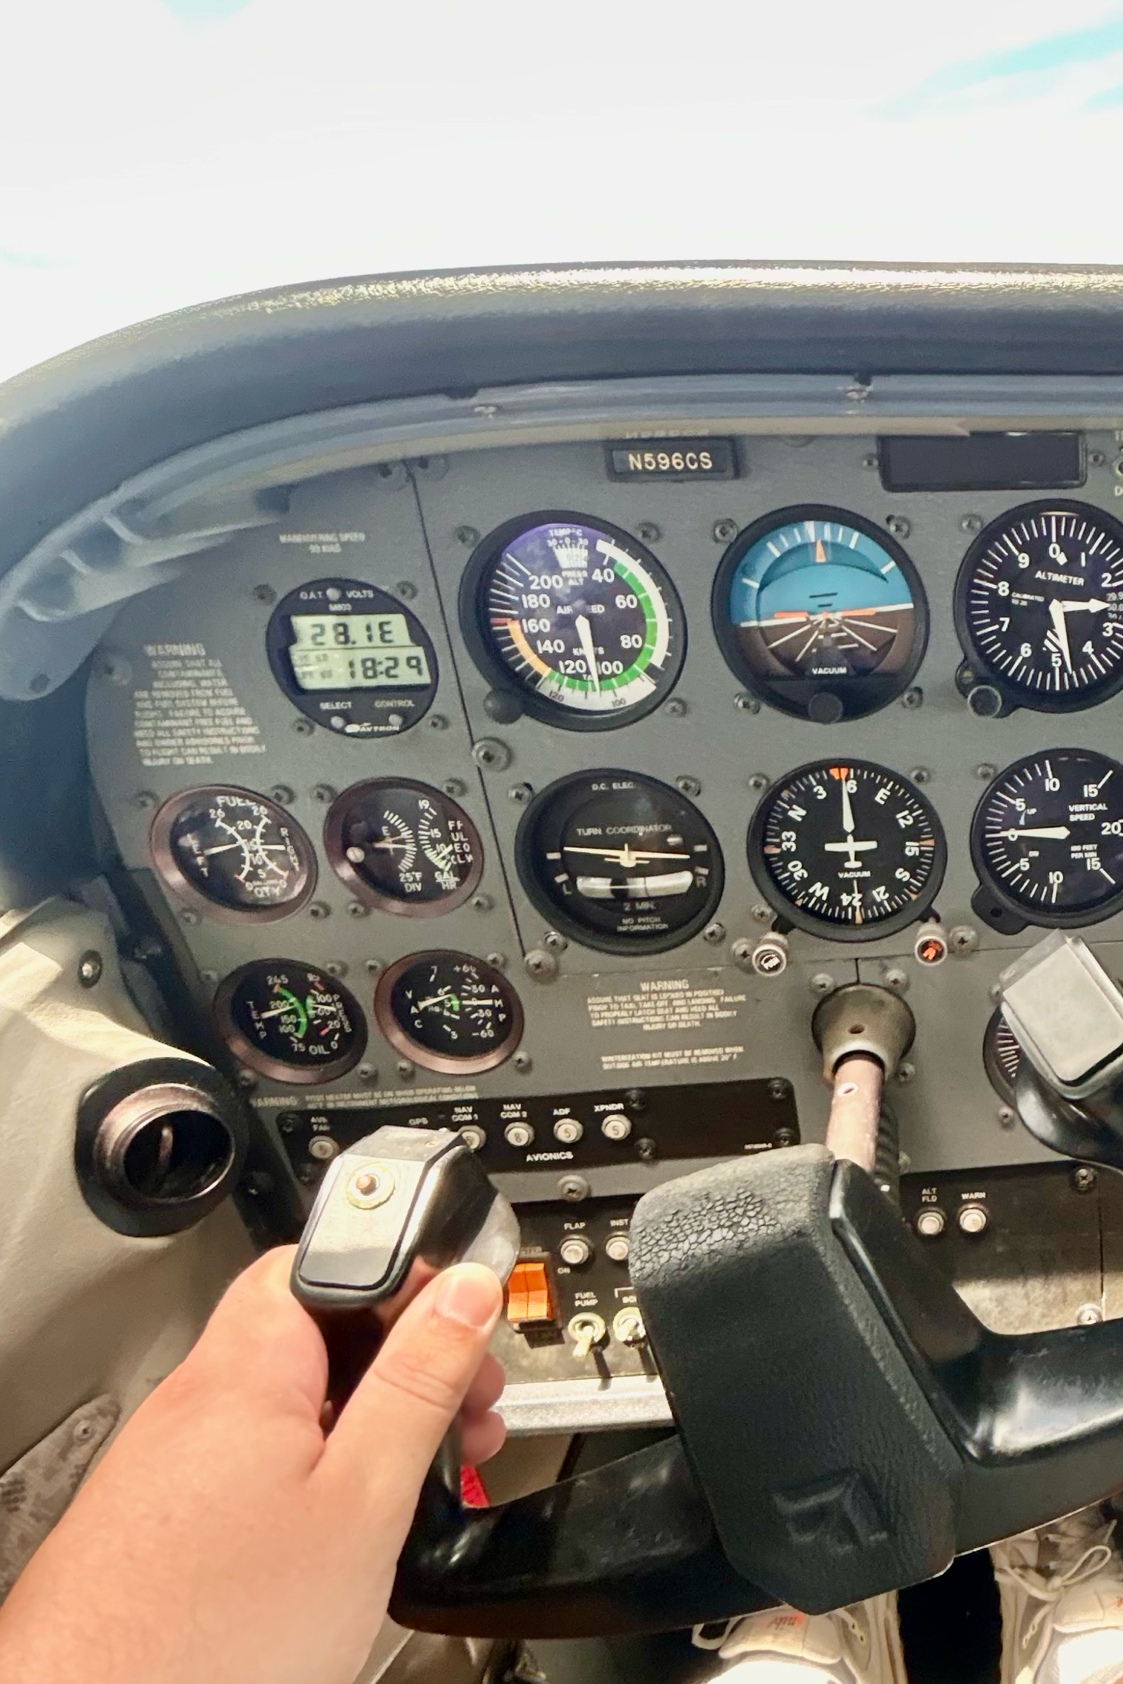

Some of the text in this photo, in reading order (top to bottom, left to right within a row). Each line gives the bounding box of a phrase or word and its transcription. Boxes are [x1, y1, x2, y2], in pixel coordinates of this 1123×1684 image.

[628, 452, 712, 470] N596CS
[1018, 553, 1030, 568] 9
[529, 575, 563, 590] 200
[592, 568, 614, 584] 40
[1035, 570, 1085, 587] ALTIMETER
[346, 590, 374, 598] VOLTS
[998, 581, 1010, 596] 8
[522, 594, 550, 609] 180
[615, 595, 638, 609] 60
[522, 620, 550, 633] 160
[999, 618, 1010, 632] 7
[1103, 622, 1114, 637] 3
[536, 639, 565, 653] 140
[620, 635, 642, 649] 80
[1082, 641, 1094, 654] 4
[143, 643, 206, 657] WARNING
[1020, 643, 1032, 657] 6
[559, 660, 586, 674] 120
[1051, 654, 1062, 667] 5
[348, 656, 423, 680] 18:29
[597, 660, 623, 675] 100
[812, 667, 847, 675] VACUUM
[846, 780, 858, 793] 6
[1045, 778, 1060, 791] 10
[1083, 784, 1098, 797] 15
[813, 785, 827, 799] 3
[874, 788, 891, 804] E
[216, 795, 257, 807] FUEL
[1015, 798, 1026, 811] 5
[1069, 803, 1108, 812] VERTICAL
[788, 804, 807, 821] N
[895, 809, 913, 828] 12
[1069, 813, 1095, 821] SPEED
[237, 820, 252, 830] 20
[576, 824, 672, 836] TURN COORDINATOR
[1101, 822, 1121, 835] 20
[430, 829, 441, 838] 15
[782, 831, 796, 852] 33
[904, 841, 919, 856] 15
[788, 861, 808, 880] 30
[1020, 858, 1030, 871] 5
[1087, 858, 1101, 870] 15
[838, 870, 871, 878] VACUUM
[895, 868, 910, 882] S
[1049, 872, 1063, 883] 10
[254, 887, 281, 897] QTY
[405, 883, 422, 892] DIV
[808, 881, 829, 900] W
[872, 885, 889, 902] 21
[840, 893, 862, 906] 24
[617, 924, 668, 932] INFORMATION
[471, 984, 485, 993] 30
[640, 979, 690, 991] WARNING
[281, 1015, 296, 1023] 150
[292, 1043, 305, 1052] 75
[309, 1045, 330, 1055] OIL
[553, 1108, 571, 1116] ADF
[594, 1103, 624, 1112] XPNDR
[501, 1111, 519, 1119] COM
[408, 1118, 428, 1126] GPS
[526, 1151, 573, 1162] AVIONICS
[962, 1192, 986, 1200] WARN
[610, 1219, 629, 1227] INST
[575, 1299, 598, 1307] PUMP
